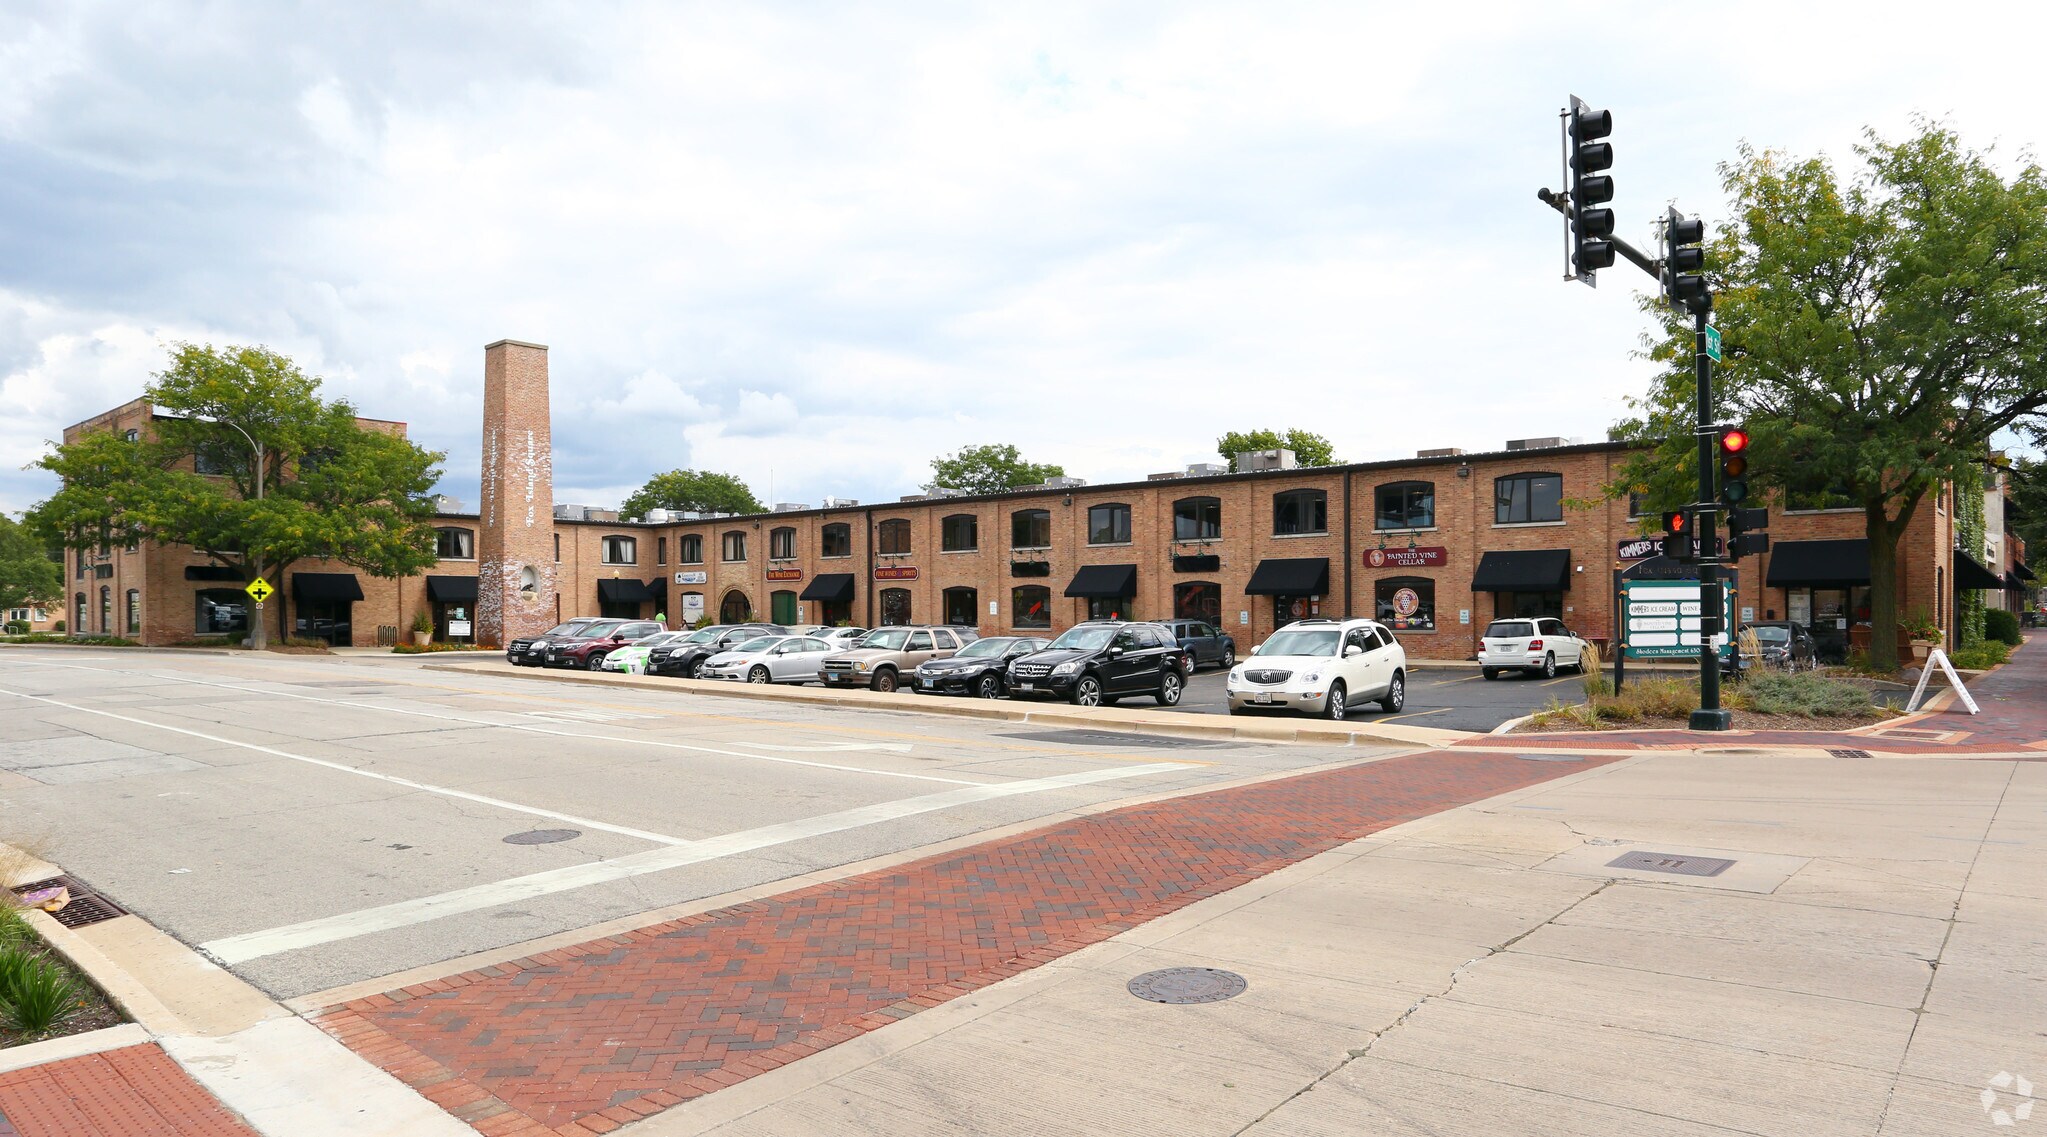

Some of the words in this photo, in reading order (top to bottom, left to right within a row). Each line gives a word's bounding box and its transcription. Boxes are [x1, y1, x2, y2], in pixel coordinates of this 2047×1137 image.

[525, 430, 536, 466] Square
[525, 468, 536, 502] Island
[525, 505, 535, 527] Fox
[1654, 541, 1663, 551] IC
